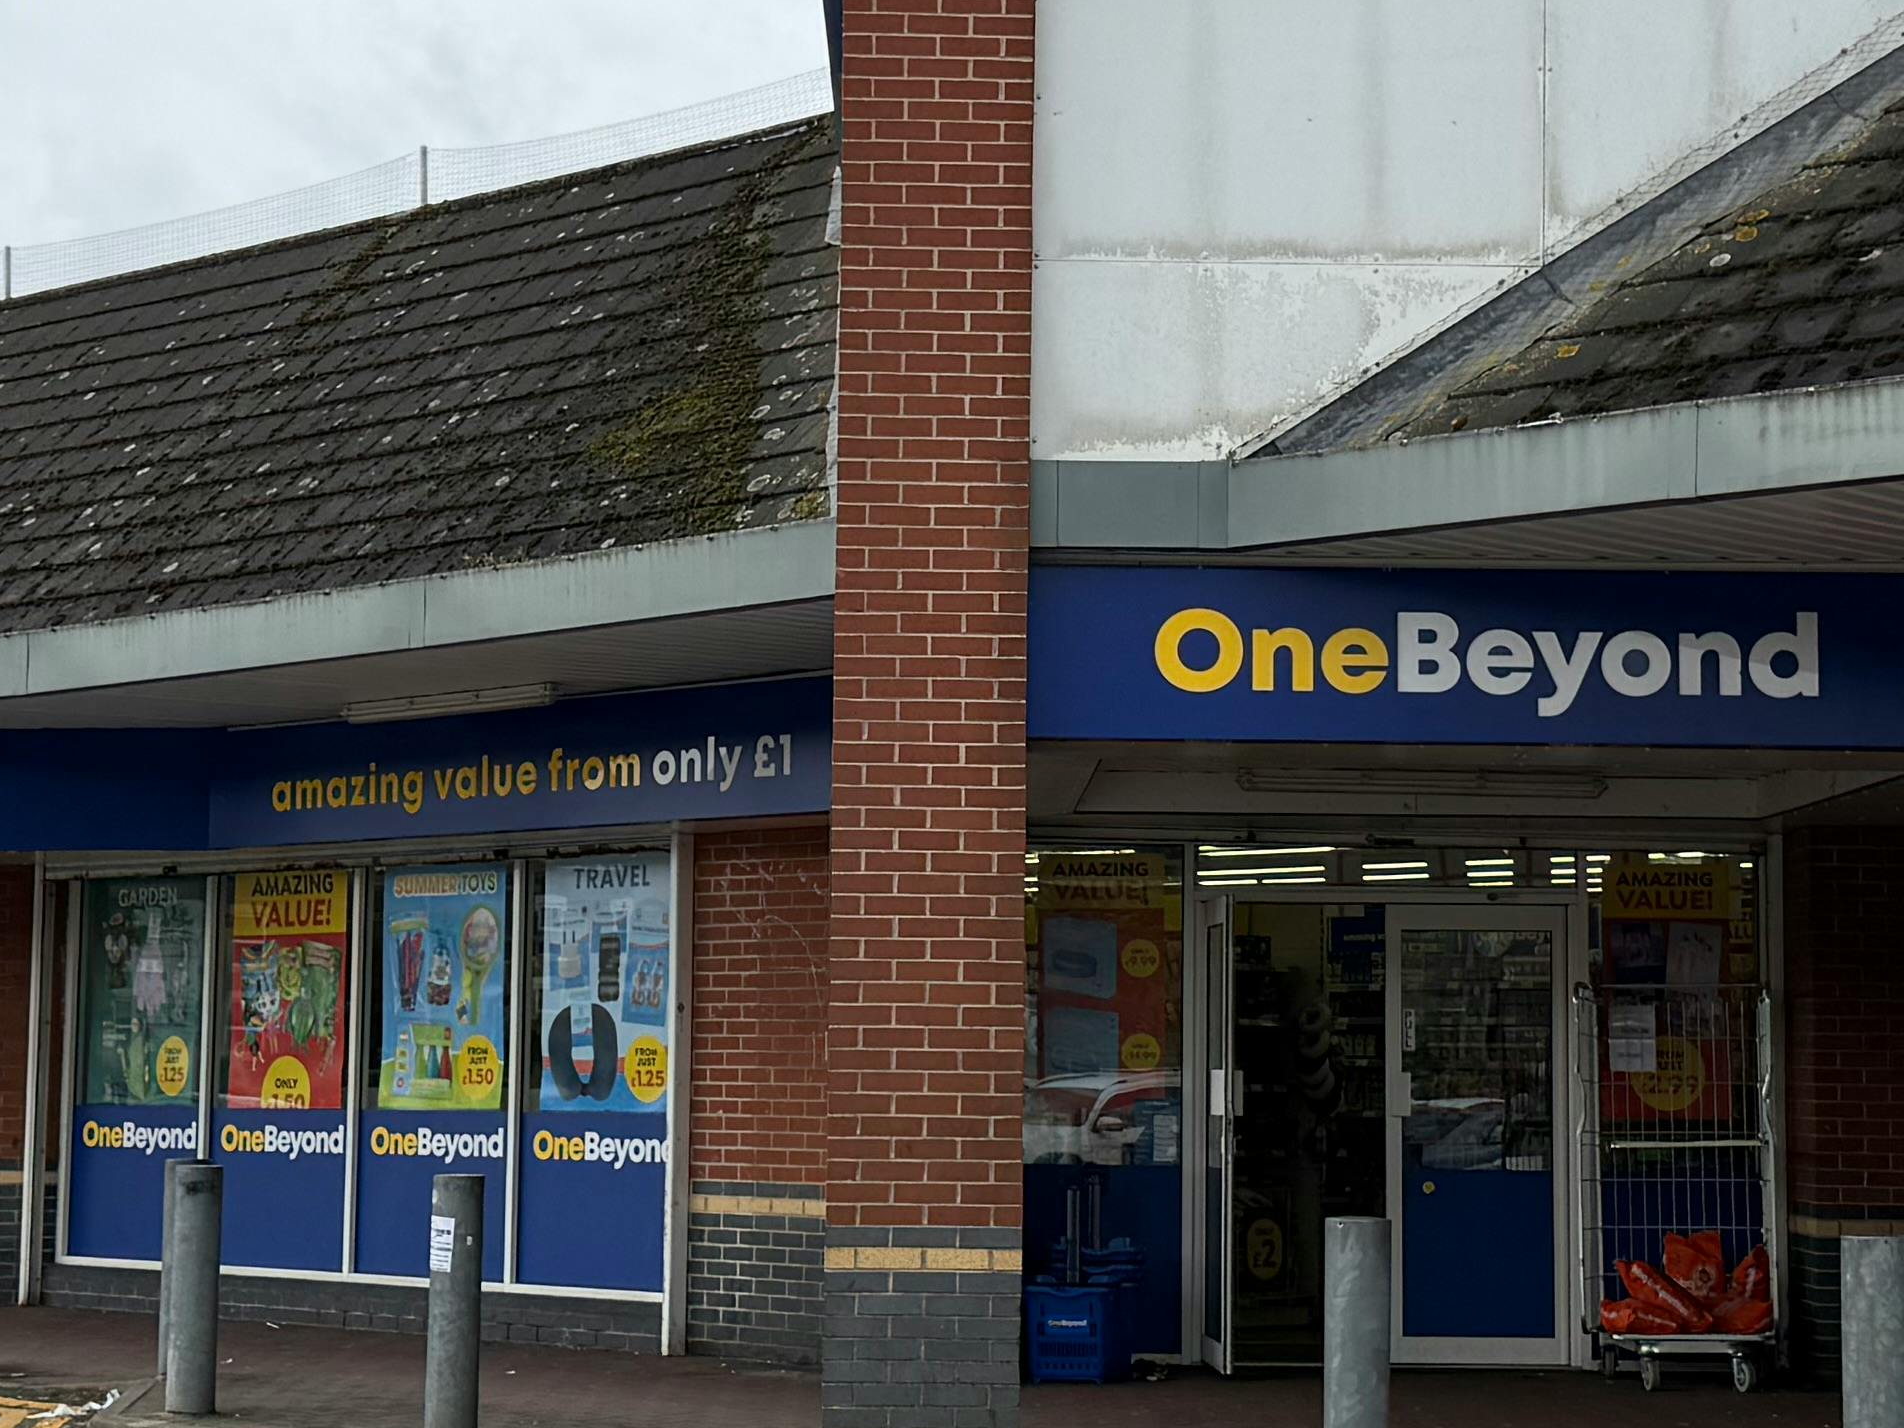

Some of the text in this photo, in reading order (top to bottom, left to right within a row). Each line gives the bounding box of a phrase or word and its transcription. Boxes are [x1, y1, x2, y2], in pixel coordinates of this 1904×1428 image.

[1153, 606, 1820, 717] OneBeyond
[271, 733, 793, 814] amazing value from only £1
[573, 864, 651, 890] TRAVEL
[1052, 861, 1149, 877] AMAZING
[1615, 871, 1713, 887] AMAZING
[251, 873, 333, 897] AMAZING
[395, 871, 497, 896] SUMMER TOYS
[118, 887, 178, 907] GARDEN
[1616, 890, 1713, 910] VALUE!
[252, 898, 332, 928] VALUE!
[635, 1048, 658, 1056] FROM
[637, 1057, 657, 1067] JUST
[275, 1077, 298, 1089] ONLY
[463, 1068, 494, 1085] £1.50
[631, 1070, 665, 1088] £1.25
[82, 1120, 197, 1156] OneBeyond
[220, 1123, 345, 1160] OneBeyond
[370, 1126, 504, 1164] OneBeyond
